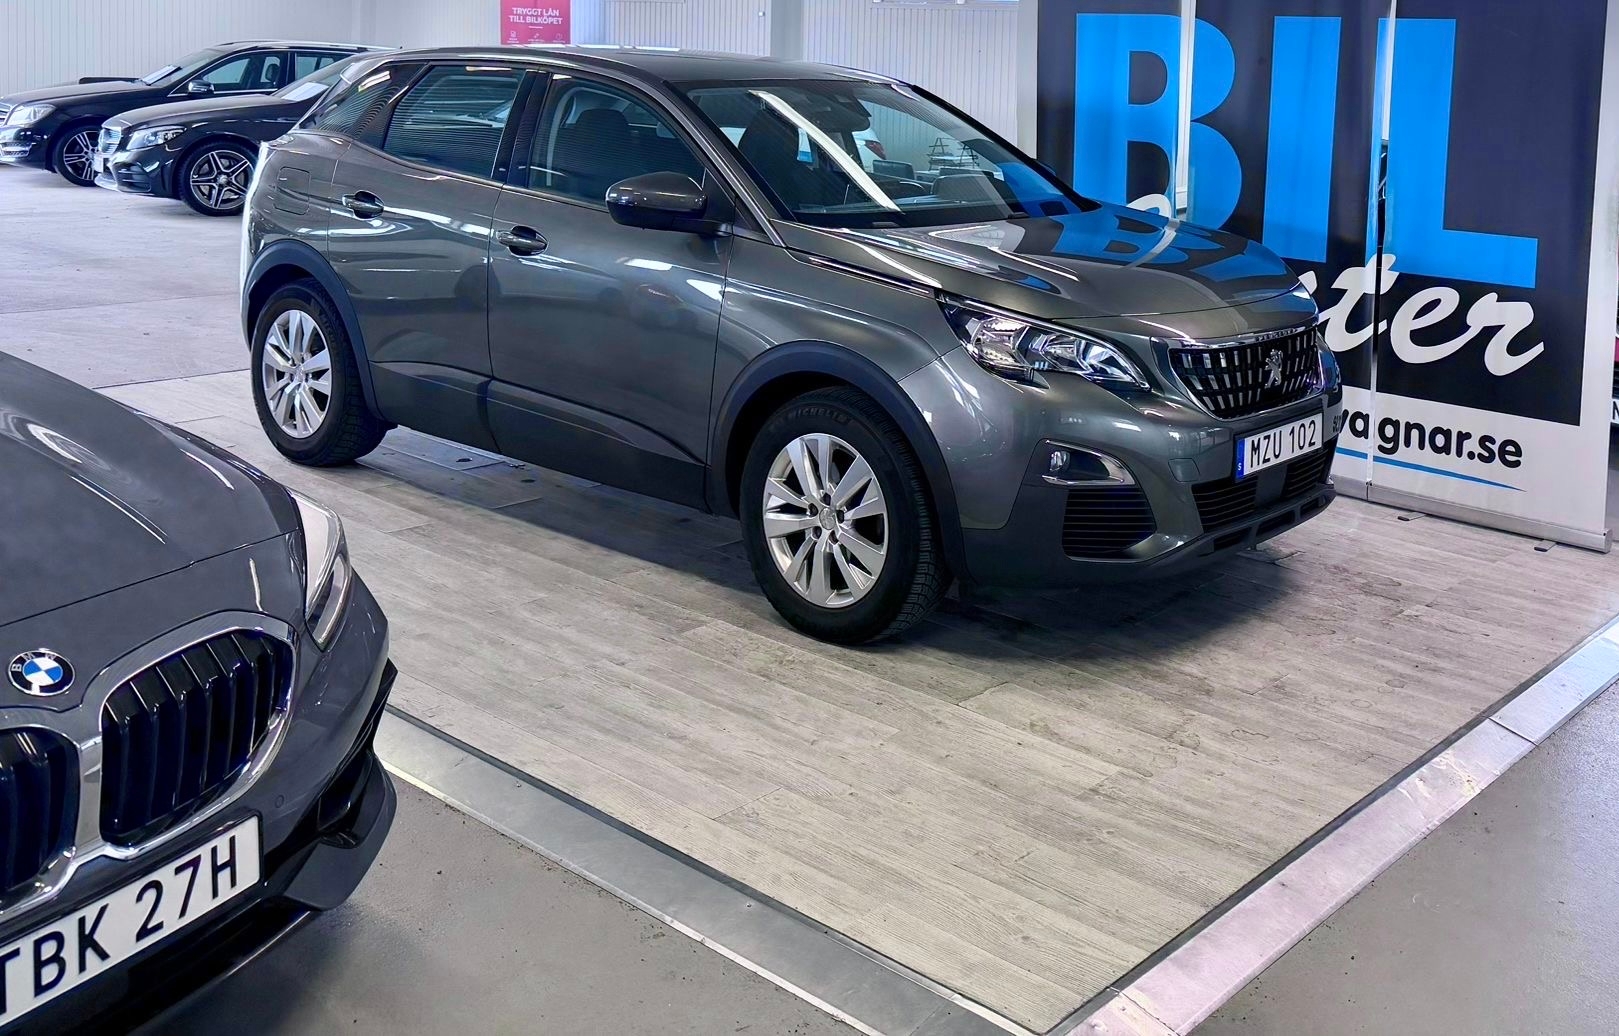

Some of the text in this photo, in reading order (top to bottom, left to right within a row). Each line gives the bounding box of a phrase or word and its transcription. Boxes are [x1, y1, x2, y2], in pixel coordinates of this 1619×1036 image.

[509, 15, 563, 24] TILL BILKÖPET
[543, 8, 559, 16] LÅN
[1073, 11, 1539, 289] BIL
[1299, 253, 1545, 376] ter
[1250, 430, 1283, 468] MZU
[1289, 419, 1317, 454] 102
[11, 651, 57, 672] BMW
[0, 834, 238, 1017] TBK 27H
